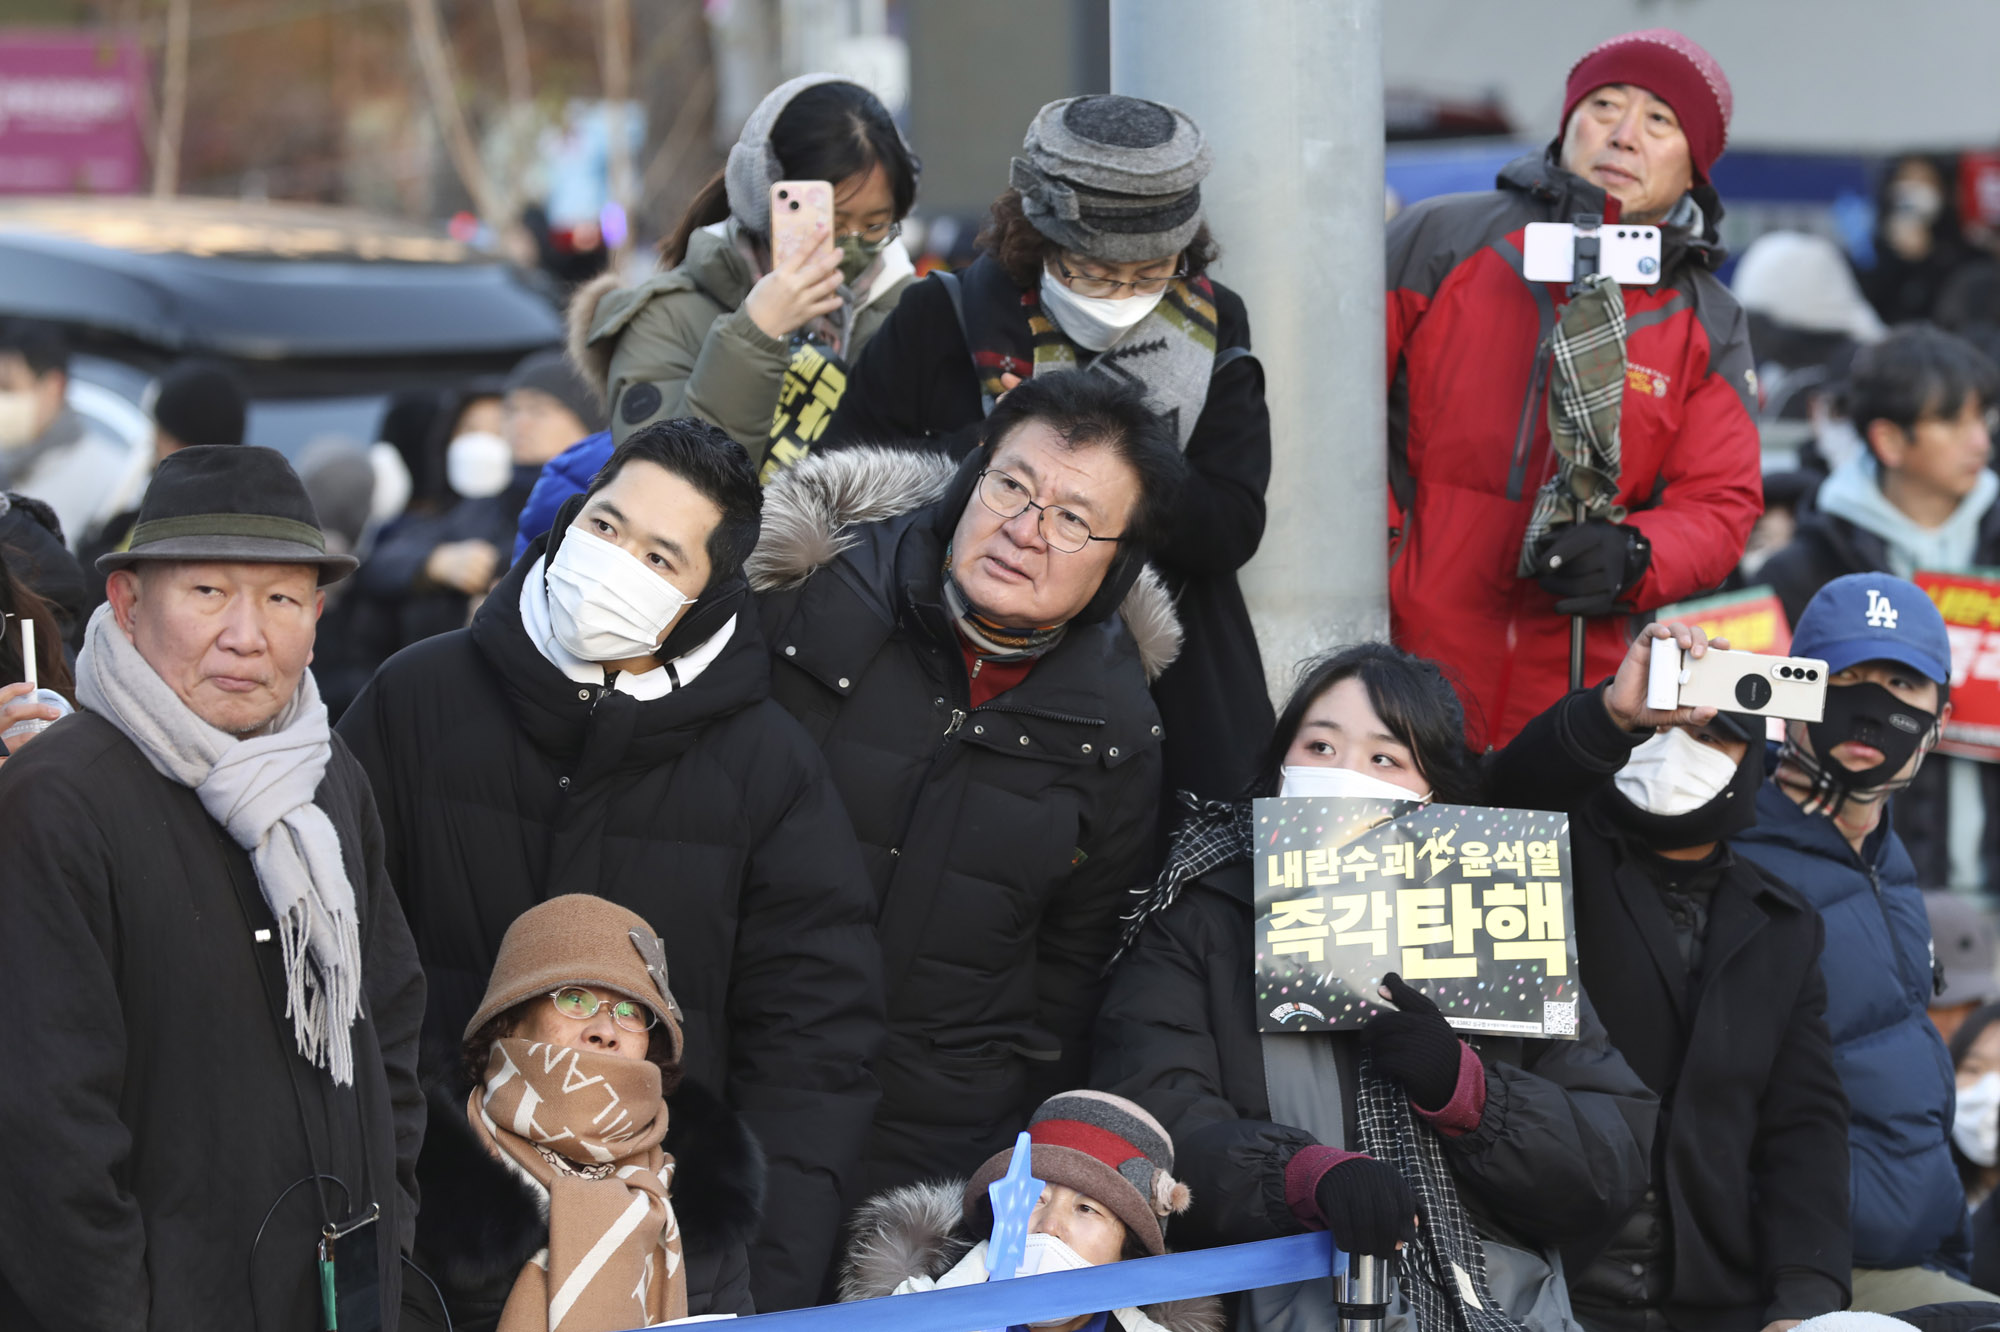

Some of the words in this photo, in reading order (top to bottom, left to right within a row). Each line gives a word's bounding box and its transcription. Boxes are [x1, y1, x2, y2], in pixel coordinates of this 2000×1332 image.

[1865, 589, 1899, 629] LA
[1267, 841, 1415, 888] 내란수괴
[1459, 839, 1561, 878] 윤석열
[1266, 890, 1393, 962] 즉각
[1396, 882, 1567, 980] 탄핵
